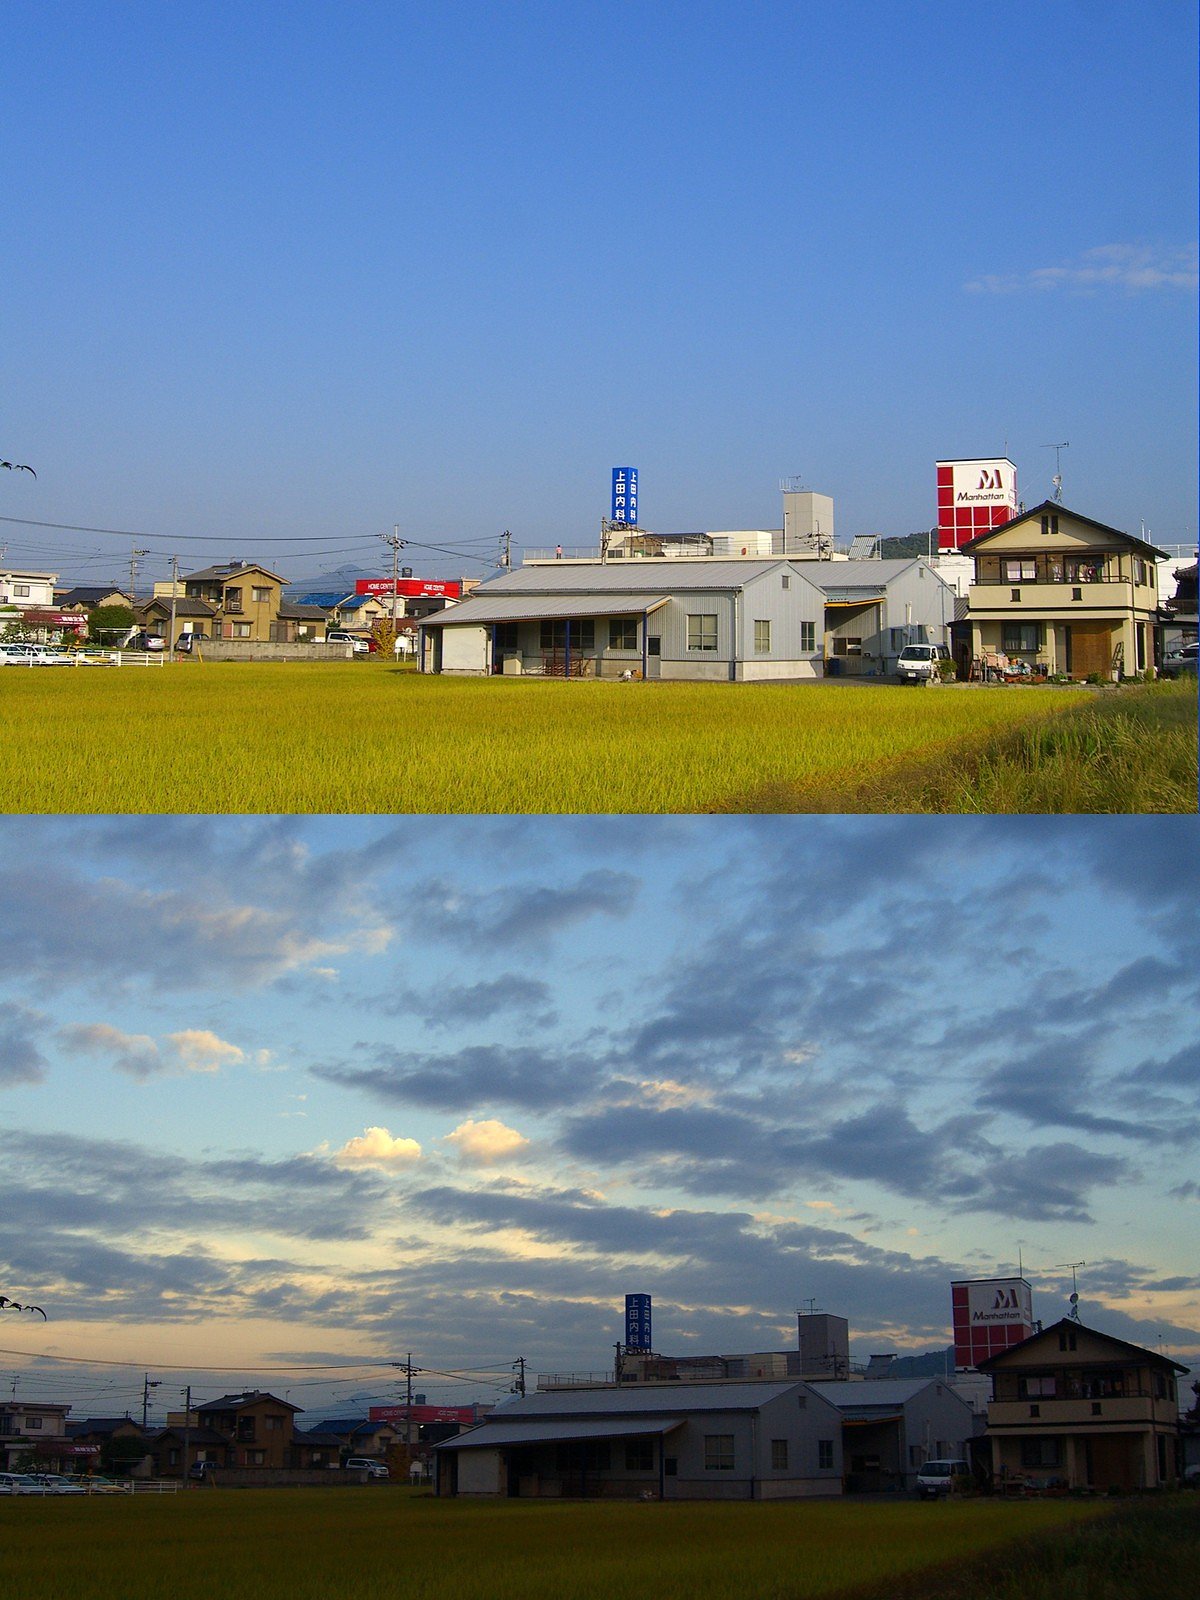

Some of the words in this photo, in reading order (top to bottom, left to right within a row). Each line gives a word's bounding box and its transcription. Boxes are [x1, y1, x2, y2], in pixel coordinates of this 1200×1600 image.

[615, 470, 626, 520] 上田内科
[957, 492, 1004, 502] Manhattan
[628, 1297, 639, 1345] 上田内科
[973, 1311, 1020, 1321] Manhattan
